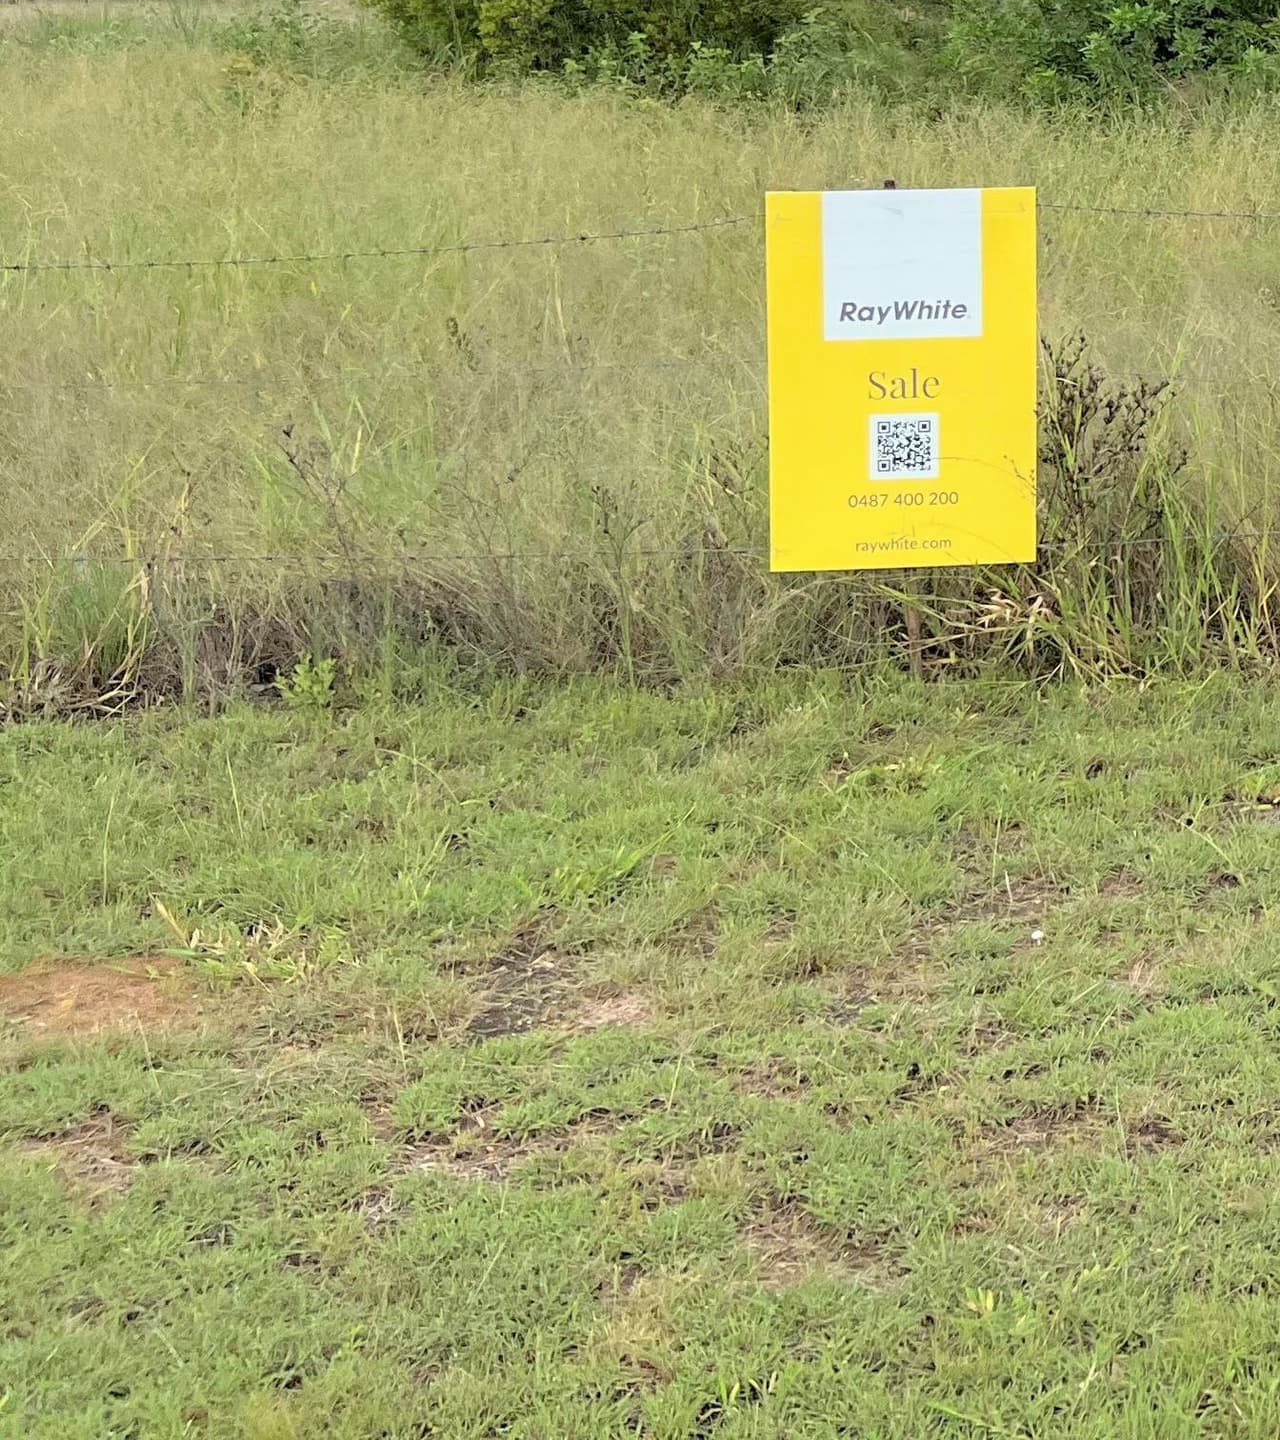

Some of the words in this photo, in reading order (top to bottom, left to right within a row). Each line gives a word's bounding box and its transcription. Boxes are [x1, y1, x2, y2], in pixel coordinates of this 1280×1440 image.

[869, 368, 940, 400] Sale
[848, 494, 888, 508] 0487
[894, 492, 924, 506] 400
[929, 491, 959, 505] 200
[855, 536, 952, 553] raywhite.com
